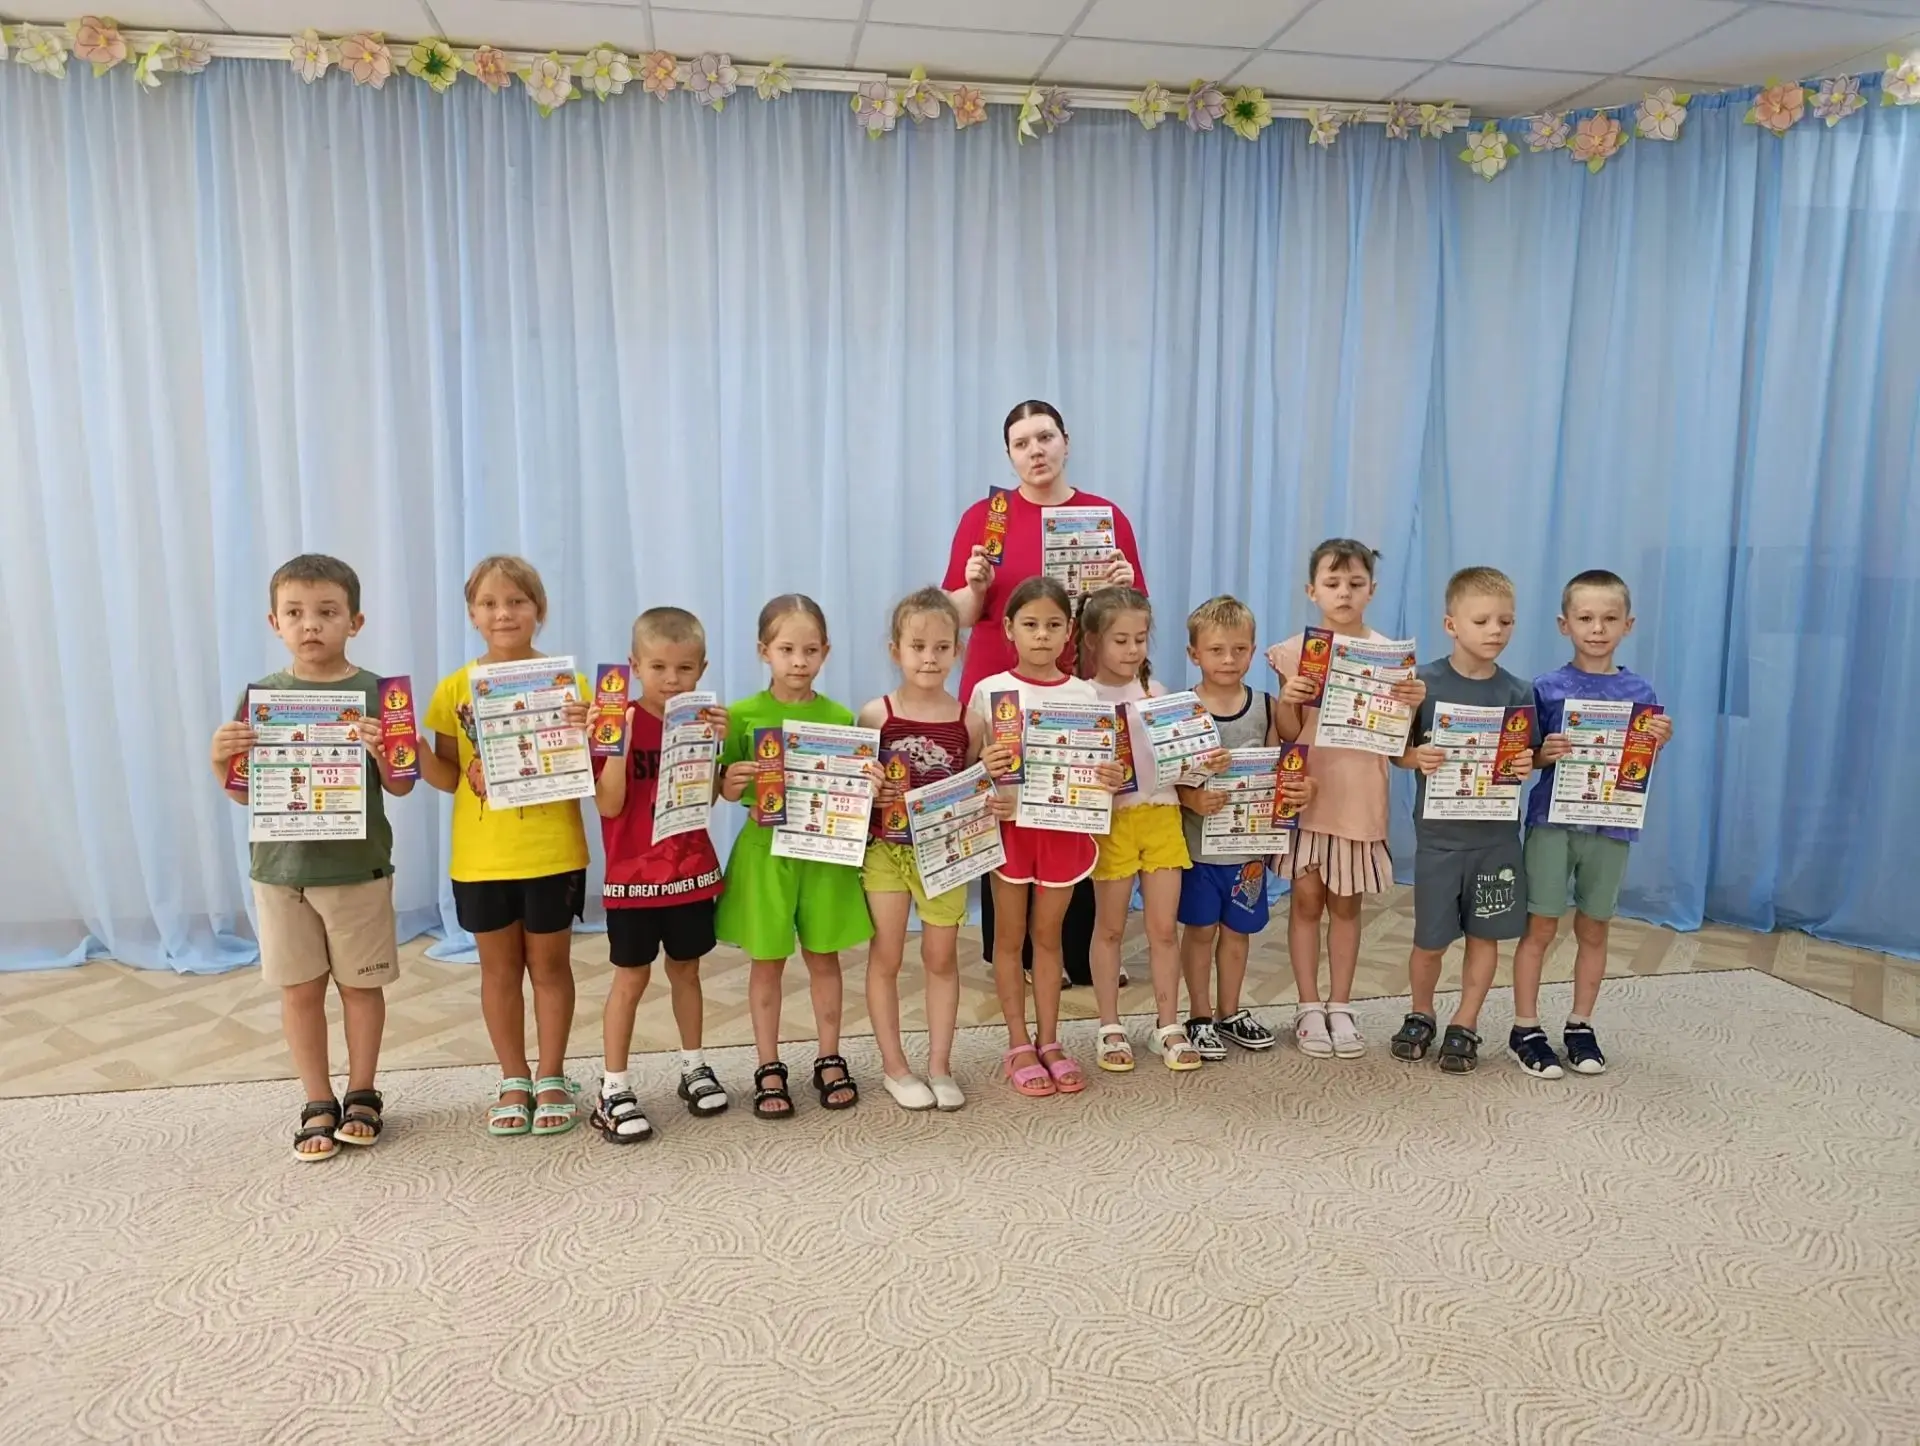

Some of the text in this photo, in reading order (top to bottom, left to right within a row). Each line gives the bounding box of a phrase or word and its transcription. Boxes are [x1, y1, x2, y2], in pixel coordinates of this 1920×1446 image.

[547, 739, 563, 747] 112
[323, 776, 340, 784] 112
[1078, 776, 1092, 784] 112
[628, 884, 660, 897] GREAT
[661, 877, 695, 896] POWER
